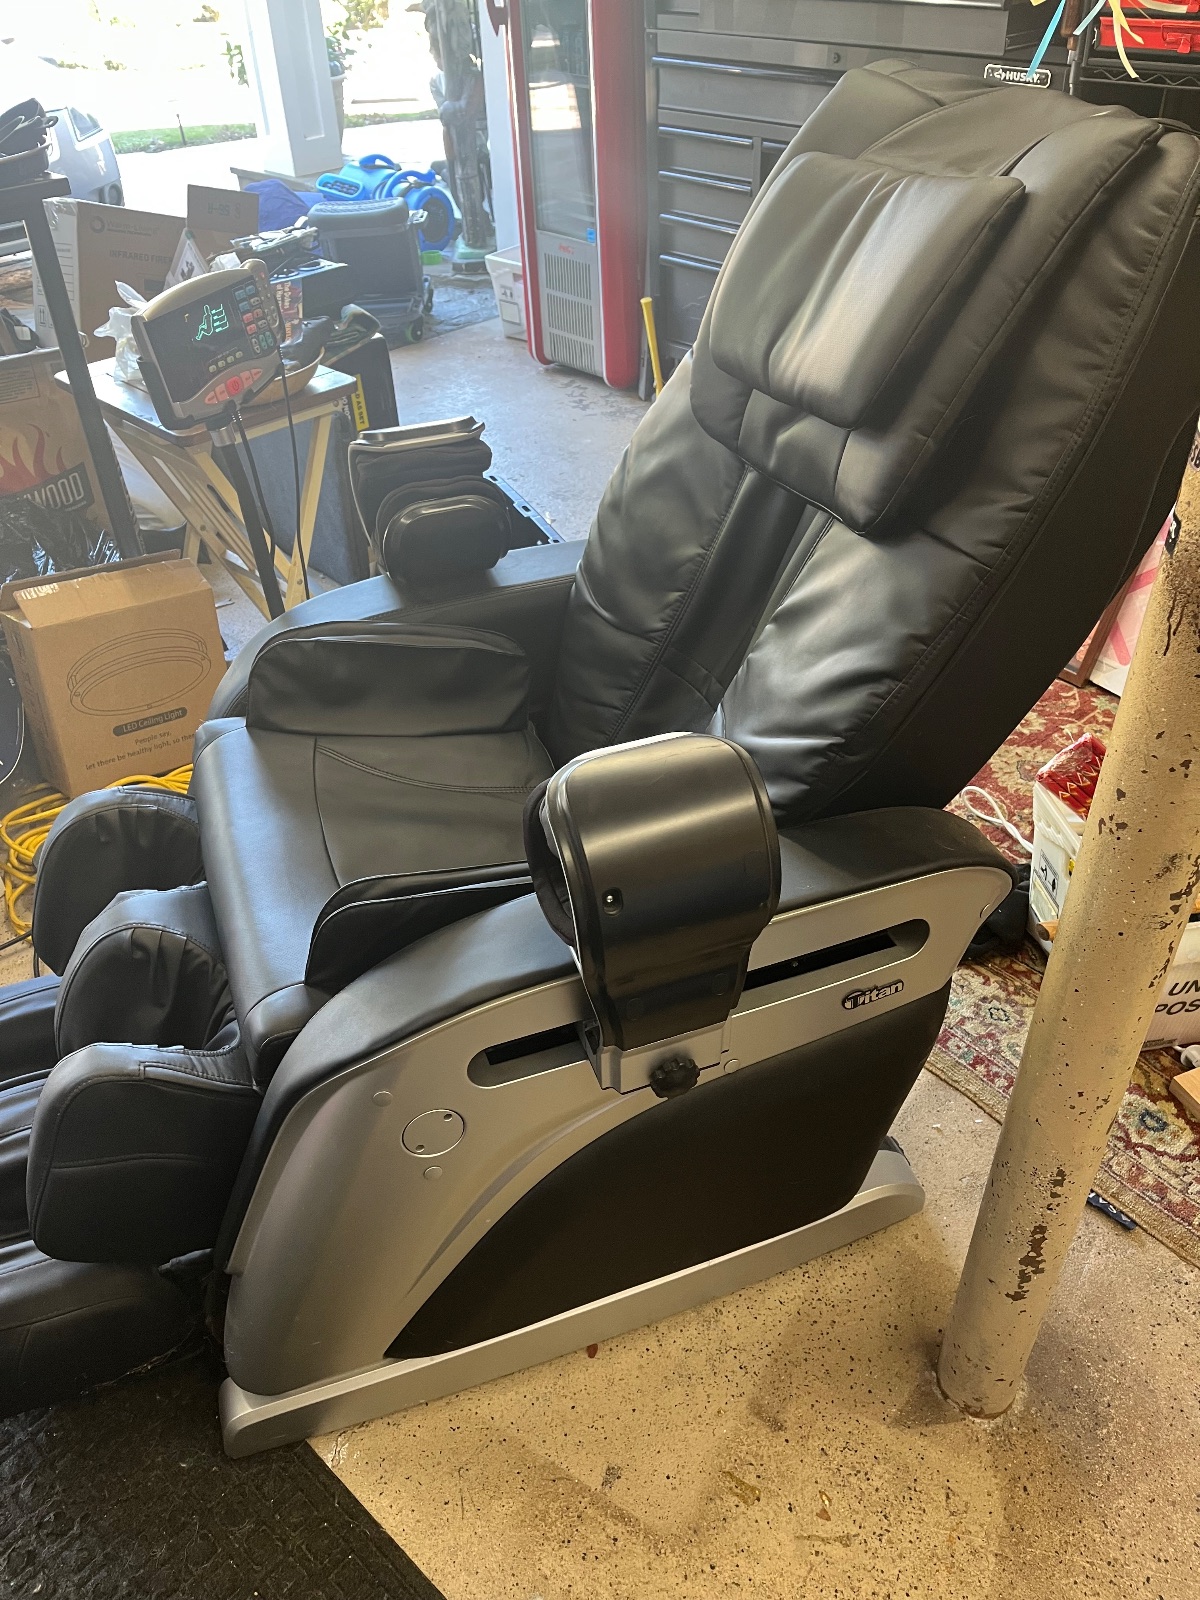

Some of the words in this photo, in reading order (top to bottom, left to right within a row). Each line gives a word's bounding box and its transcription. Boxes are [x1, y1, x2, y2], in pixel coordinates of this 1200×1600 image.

[110, 250, 149, 262] INFRARED
[356, 400, 363, 410] AS
[17, 472, 84, 509] WOOD
[123, 722, 138, 733] LED
[138, 716, 164, 729] Ceiling
[164, 709, 183, 721] Light
[135, 734, 158, 745] People
[97, 758, 115, 767] there
[127, 747, 152, 758] healthy
[843, 980, 904, 1010] Titan
